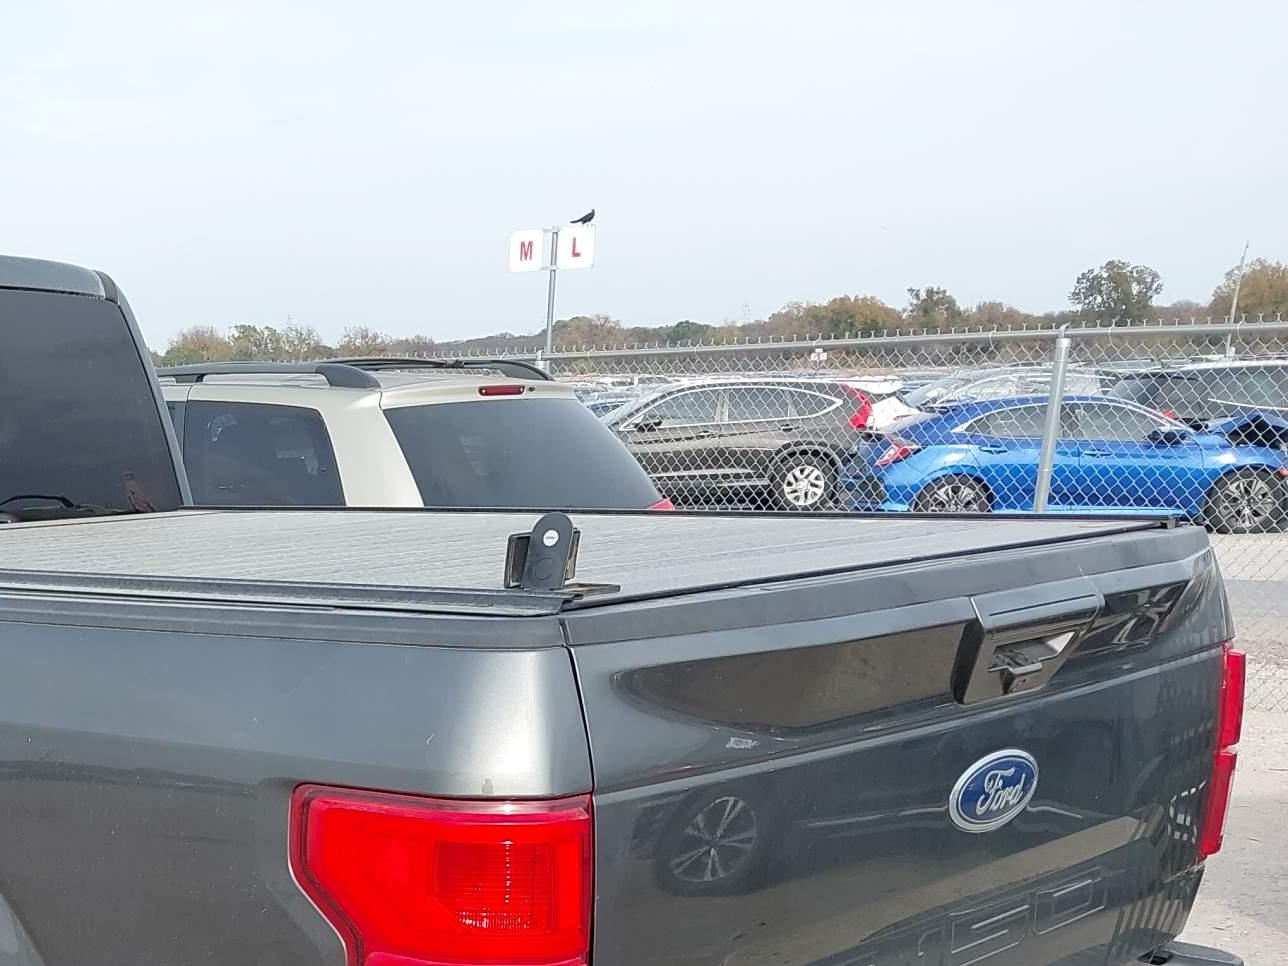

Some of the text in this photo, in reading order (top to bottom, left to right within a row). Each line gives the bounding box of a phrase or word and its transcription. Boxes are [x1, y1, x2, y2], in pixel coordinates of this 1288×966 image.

[519, 240, 533, 261] M
[572, 237, 581, 257] L
[977, 767, 1026, 815] Ford
